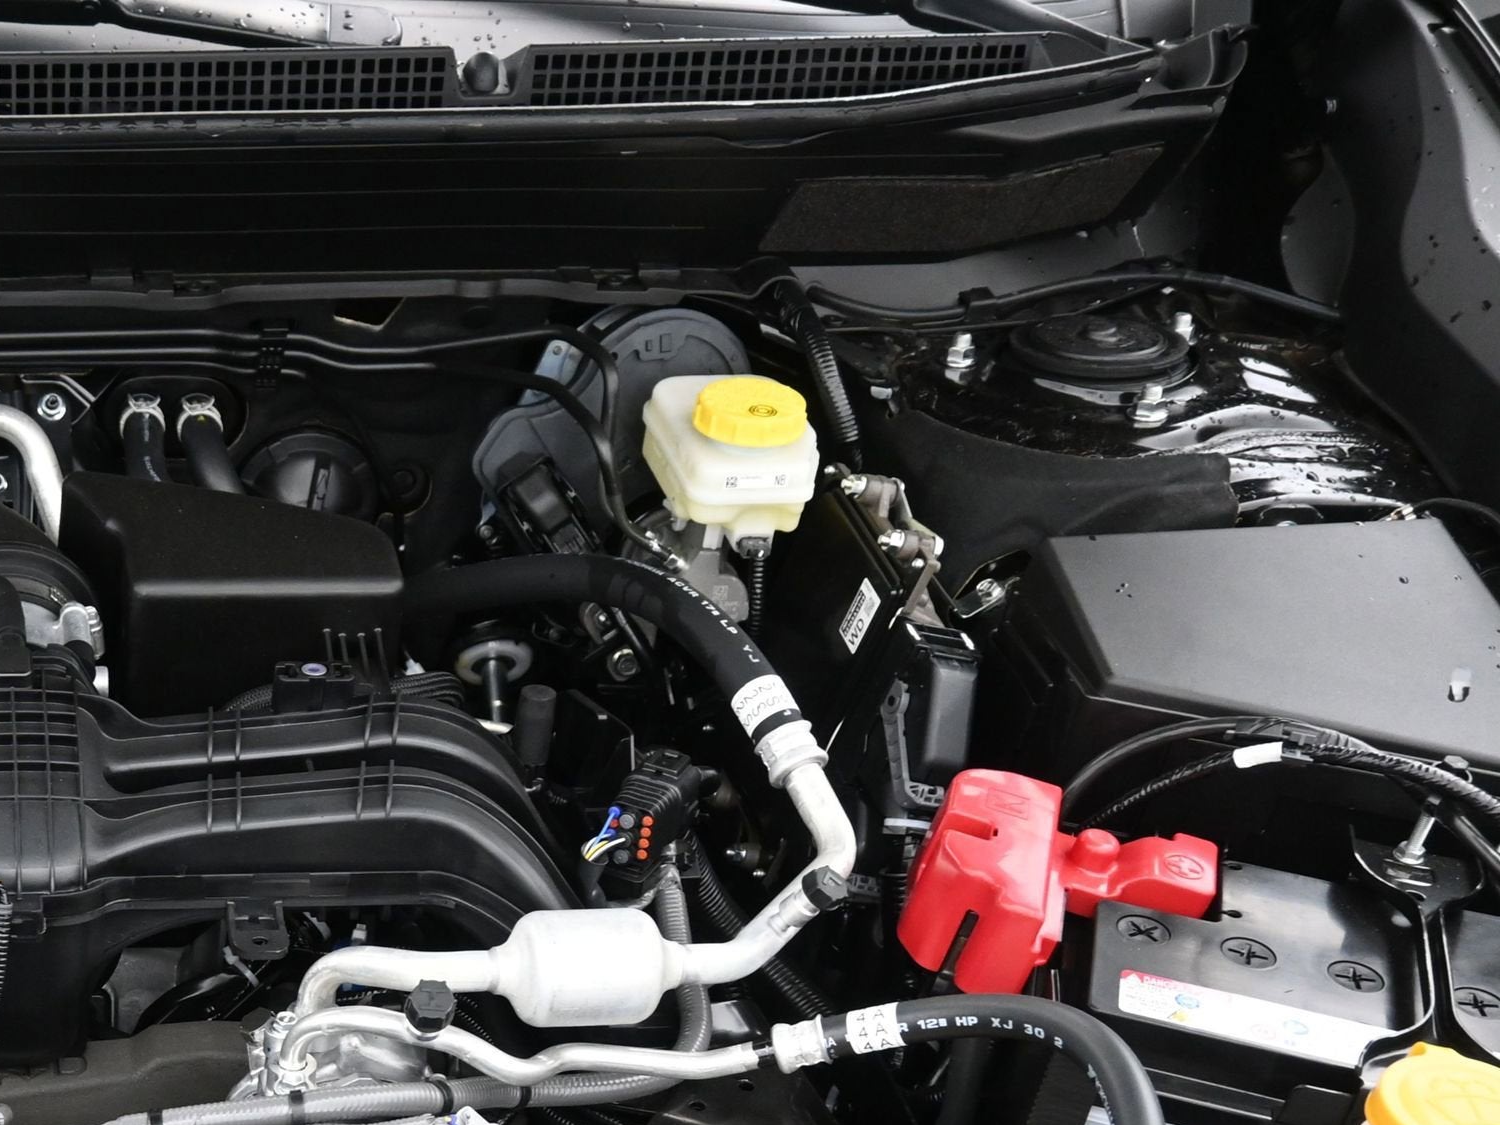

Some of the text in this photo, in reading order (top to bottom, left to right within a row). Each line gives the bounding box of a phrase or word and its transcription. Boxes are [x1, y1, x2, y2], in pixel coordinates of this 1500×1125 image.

[720, 619, 738, 634] LP
[955, 1016, 978, 1027] HP
[991, 1017, 1014, 1030] XJ
[1023, 1023, 1045, 1039] 30
[1053, 1036, 1064, 1049] 2
